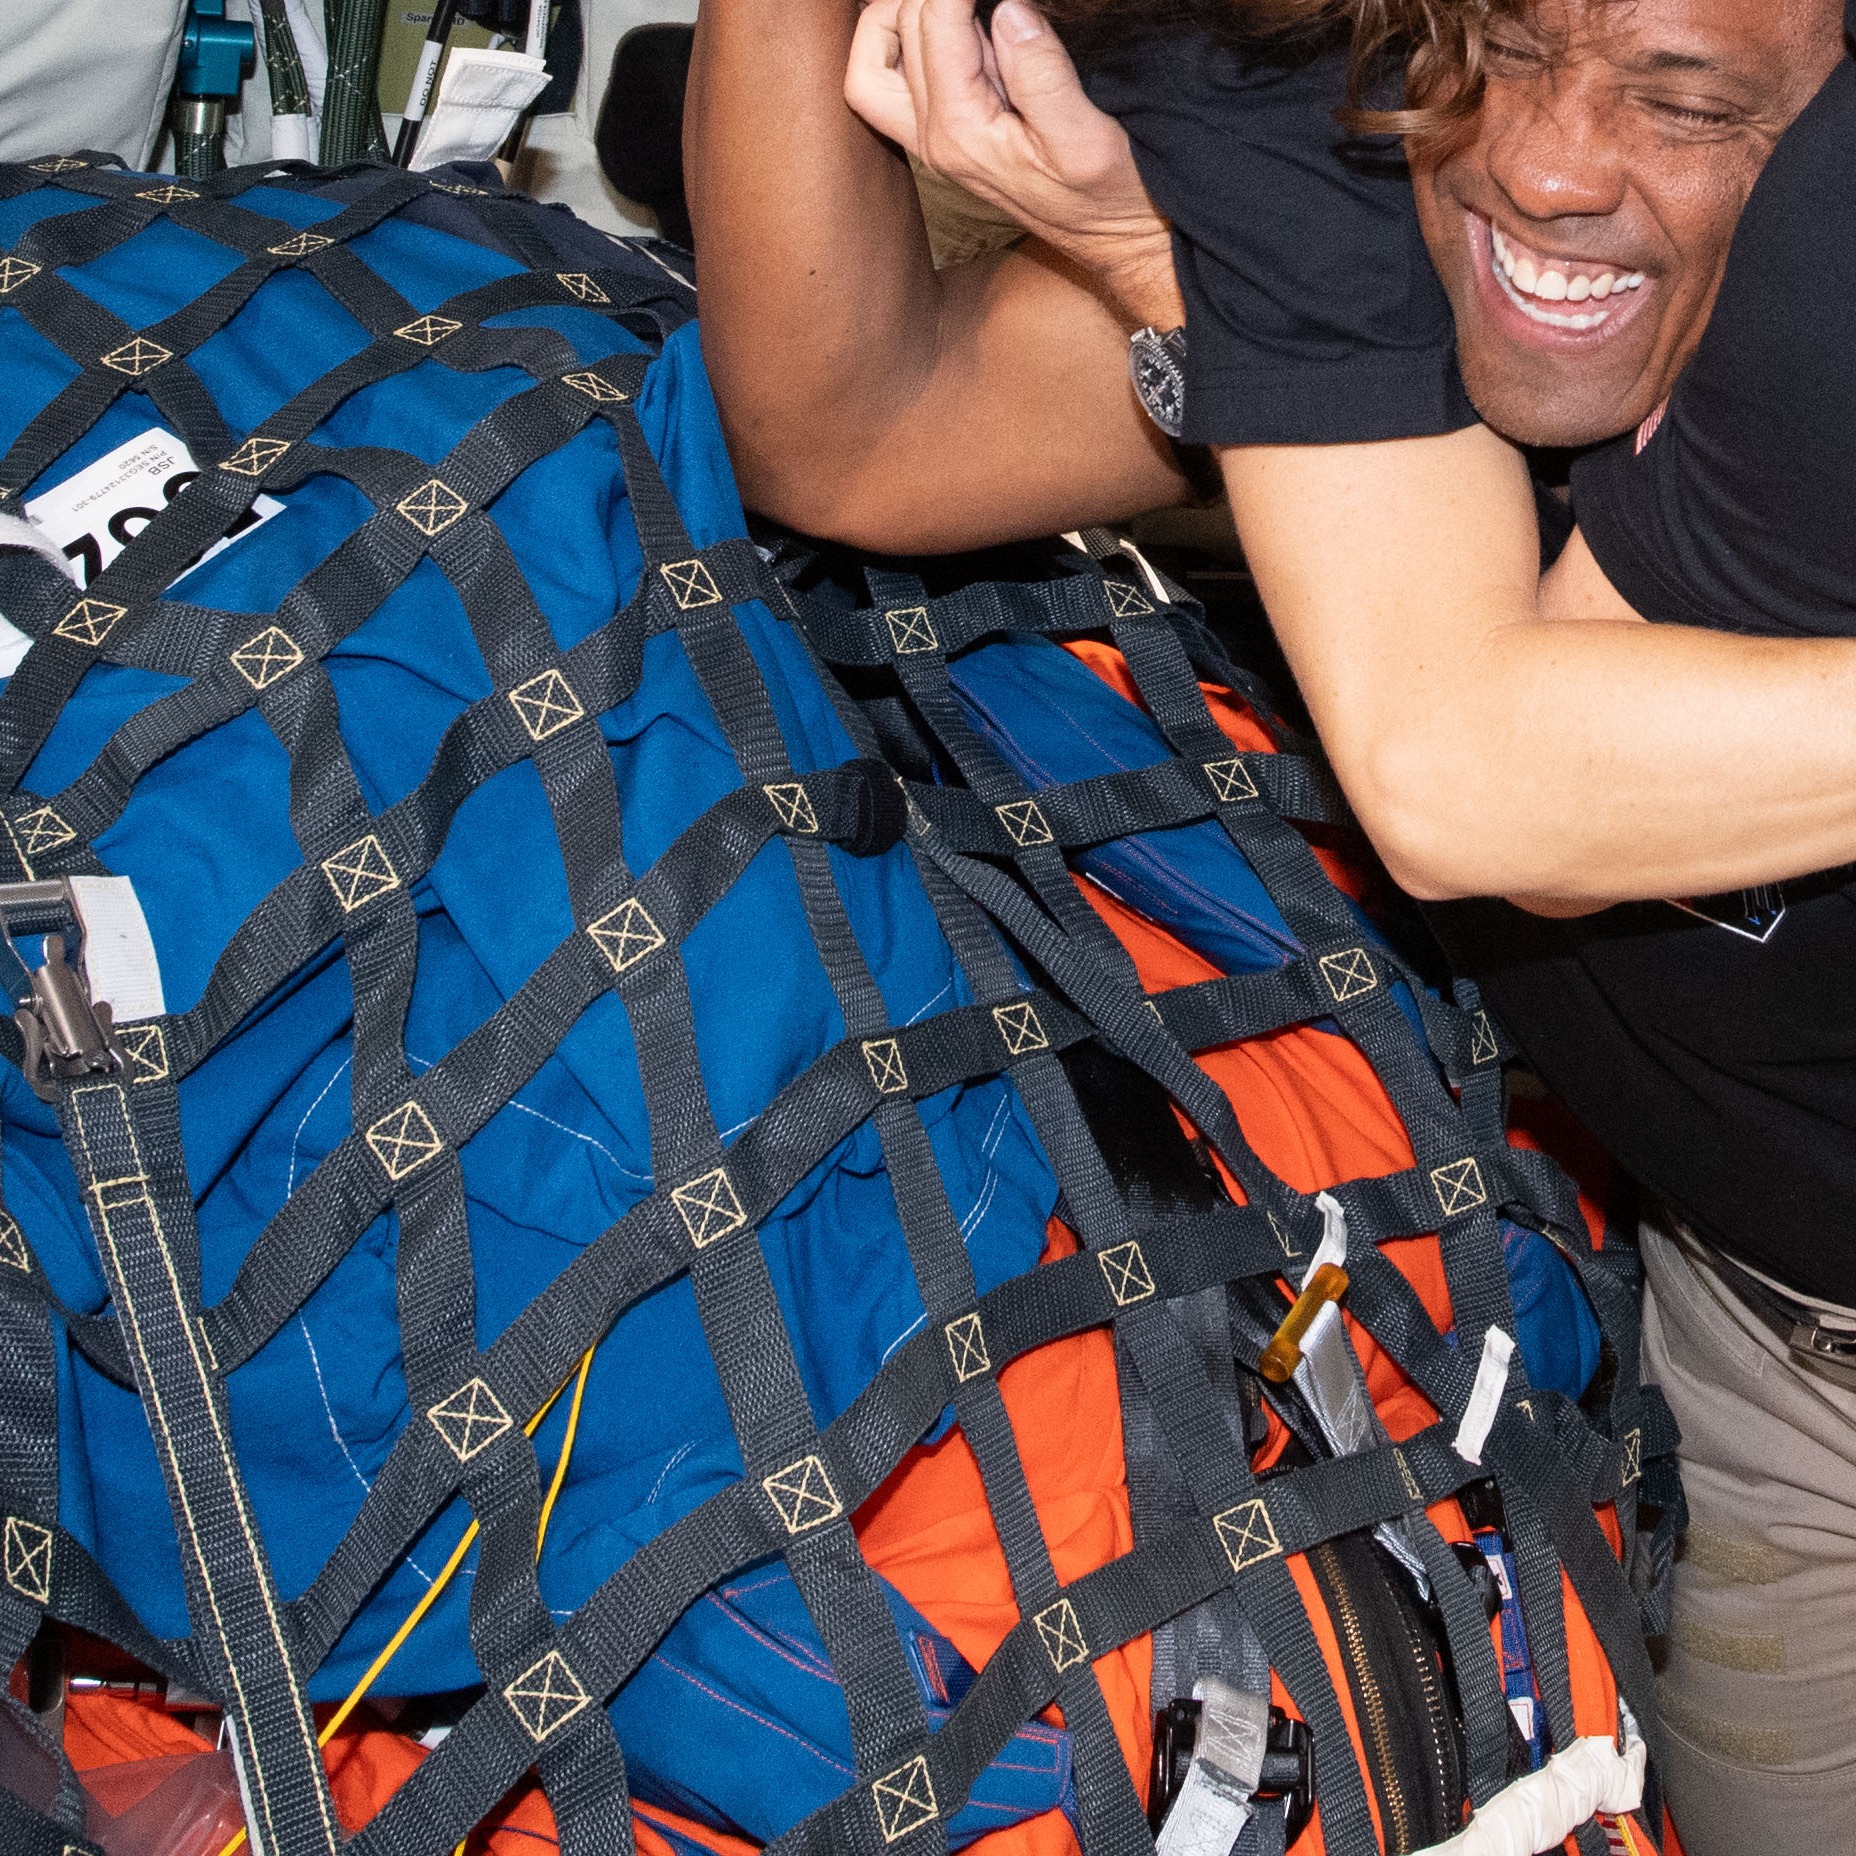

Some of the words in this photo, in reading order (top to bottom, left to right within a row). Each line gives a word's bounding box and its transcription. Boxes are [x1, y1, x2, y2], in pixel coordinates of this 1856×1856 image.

[406, 12, 432, 24] Spar
[420, 88, 429, 106] DO
[425, 59, 437, 88] NOT
[140, 445, 159, 458] S/N
[146, 450, 167, 467] P/N
[150, 456, 176, 477] JSB
